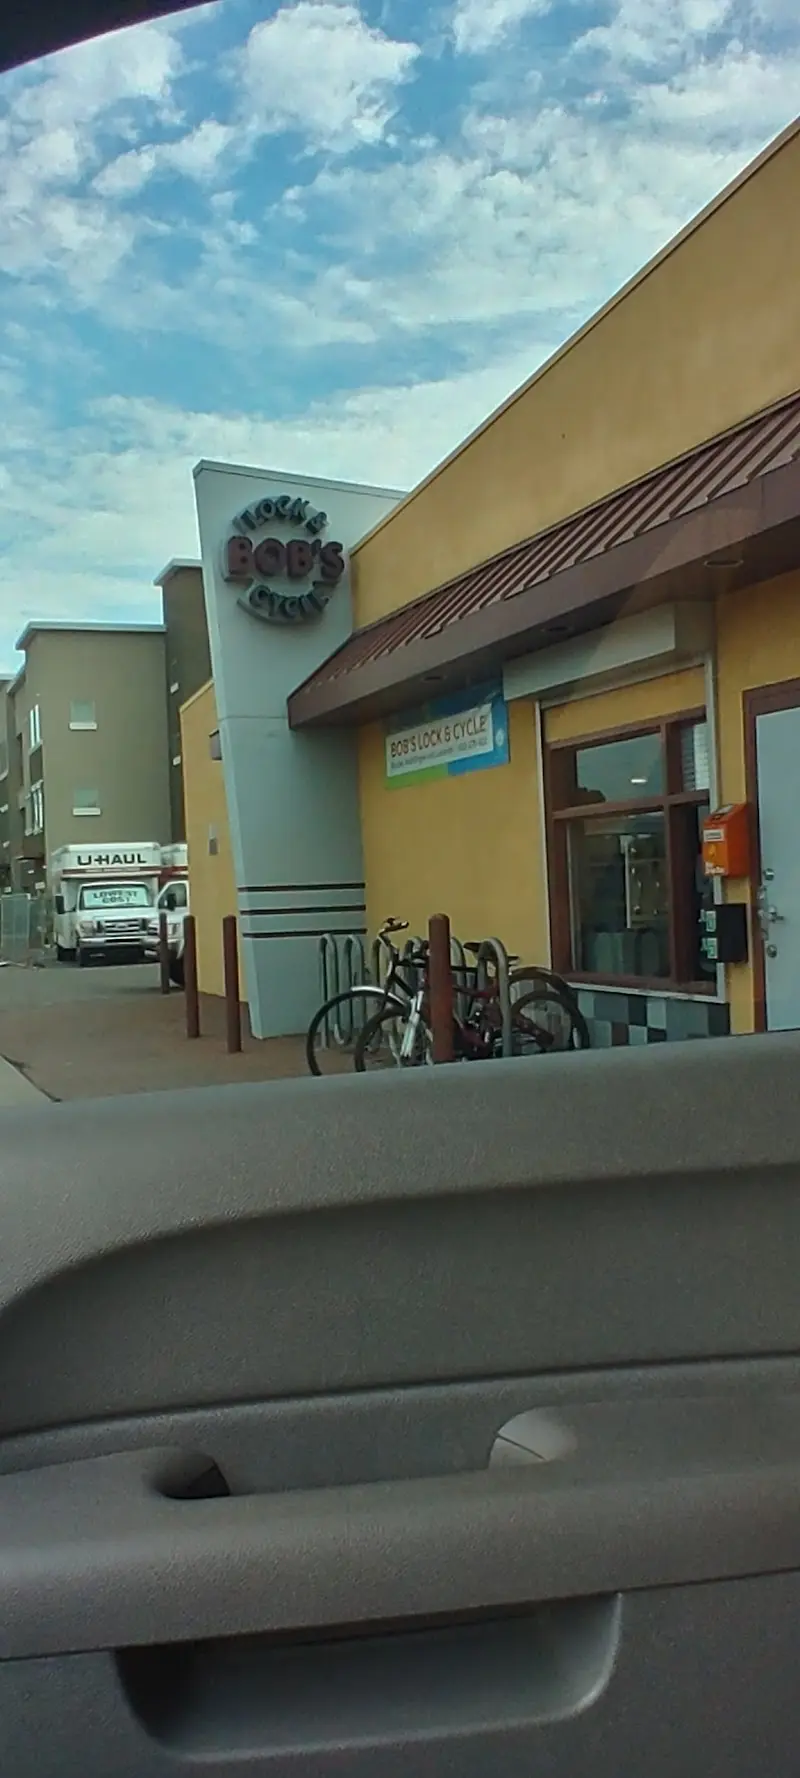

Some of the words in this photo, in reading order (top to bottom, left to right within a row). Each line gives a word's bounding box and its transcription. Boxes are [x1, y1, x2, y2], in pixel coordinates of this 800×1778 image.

[233, 495, 310, 532] LOCK
[305, 511, 330, 534] &
[227, 535, 345, 580] BOB'S
[390, 735, 417, 759] BOB'S
[418, 727, 443, 750] LOCK
[444, 725, 451, 742] &
[453, 715, 487, 740] CYCLE
[76, 853, 147, 866] U-HAUL
[92, 890, 138, 899] LOWEST
